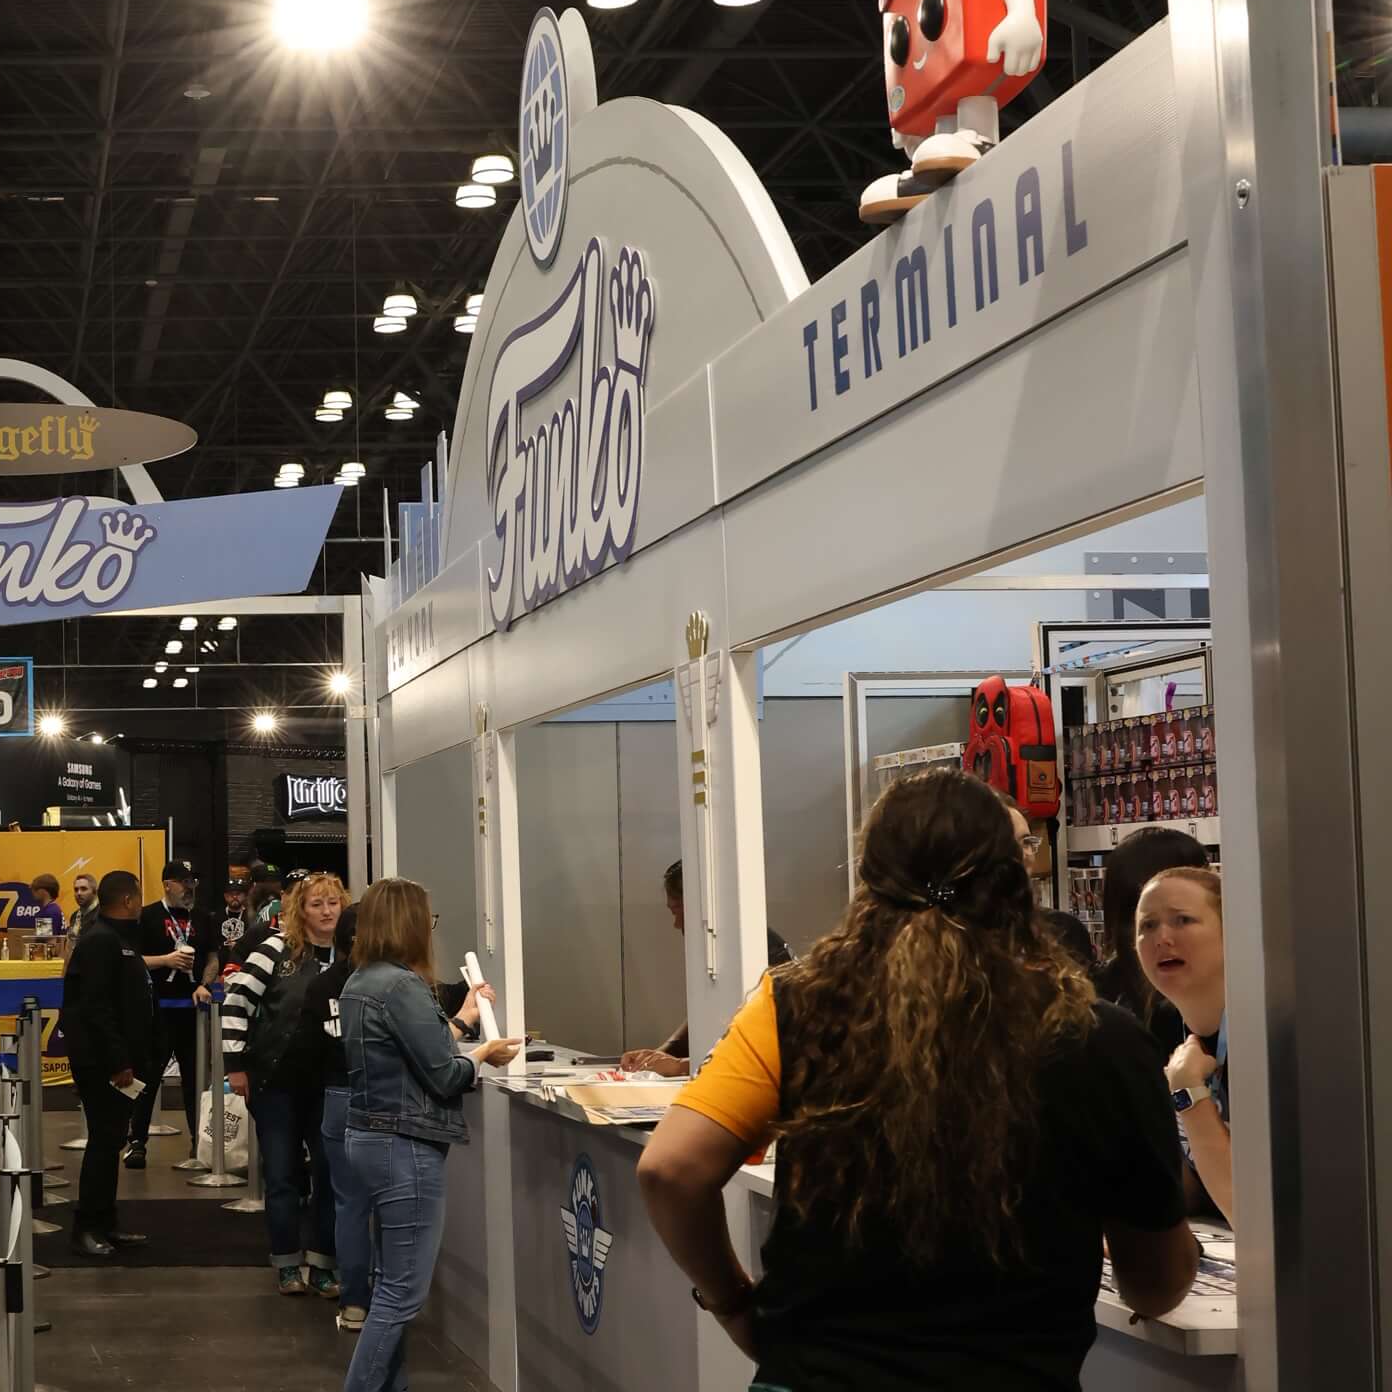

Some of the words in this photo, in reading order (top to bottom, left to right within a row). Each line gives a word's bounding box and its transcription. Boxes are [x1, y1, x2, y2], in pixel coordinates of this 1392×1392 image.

[802, 139, 1088, 412] TERMINAL
[487, 237, 646, 632] Funko
[67, 762, 93, 775] SAMSUNG
[63, 777, 78, 791] Galaxy
[16, 905, 41, 917] BAP
